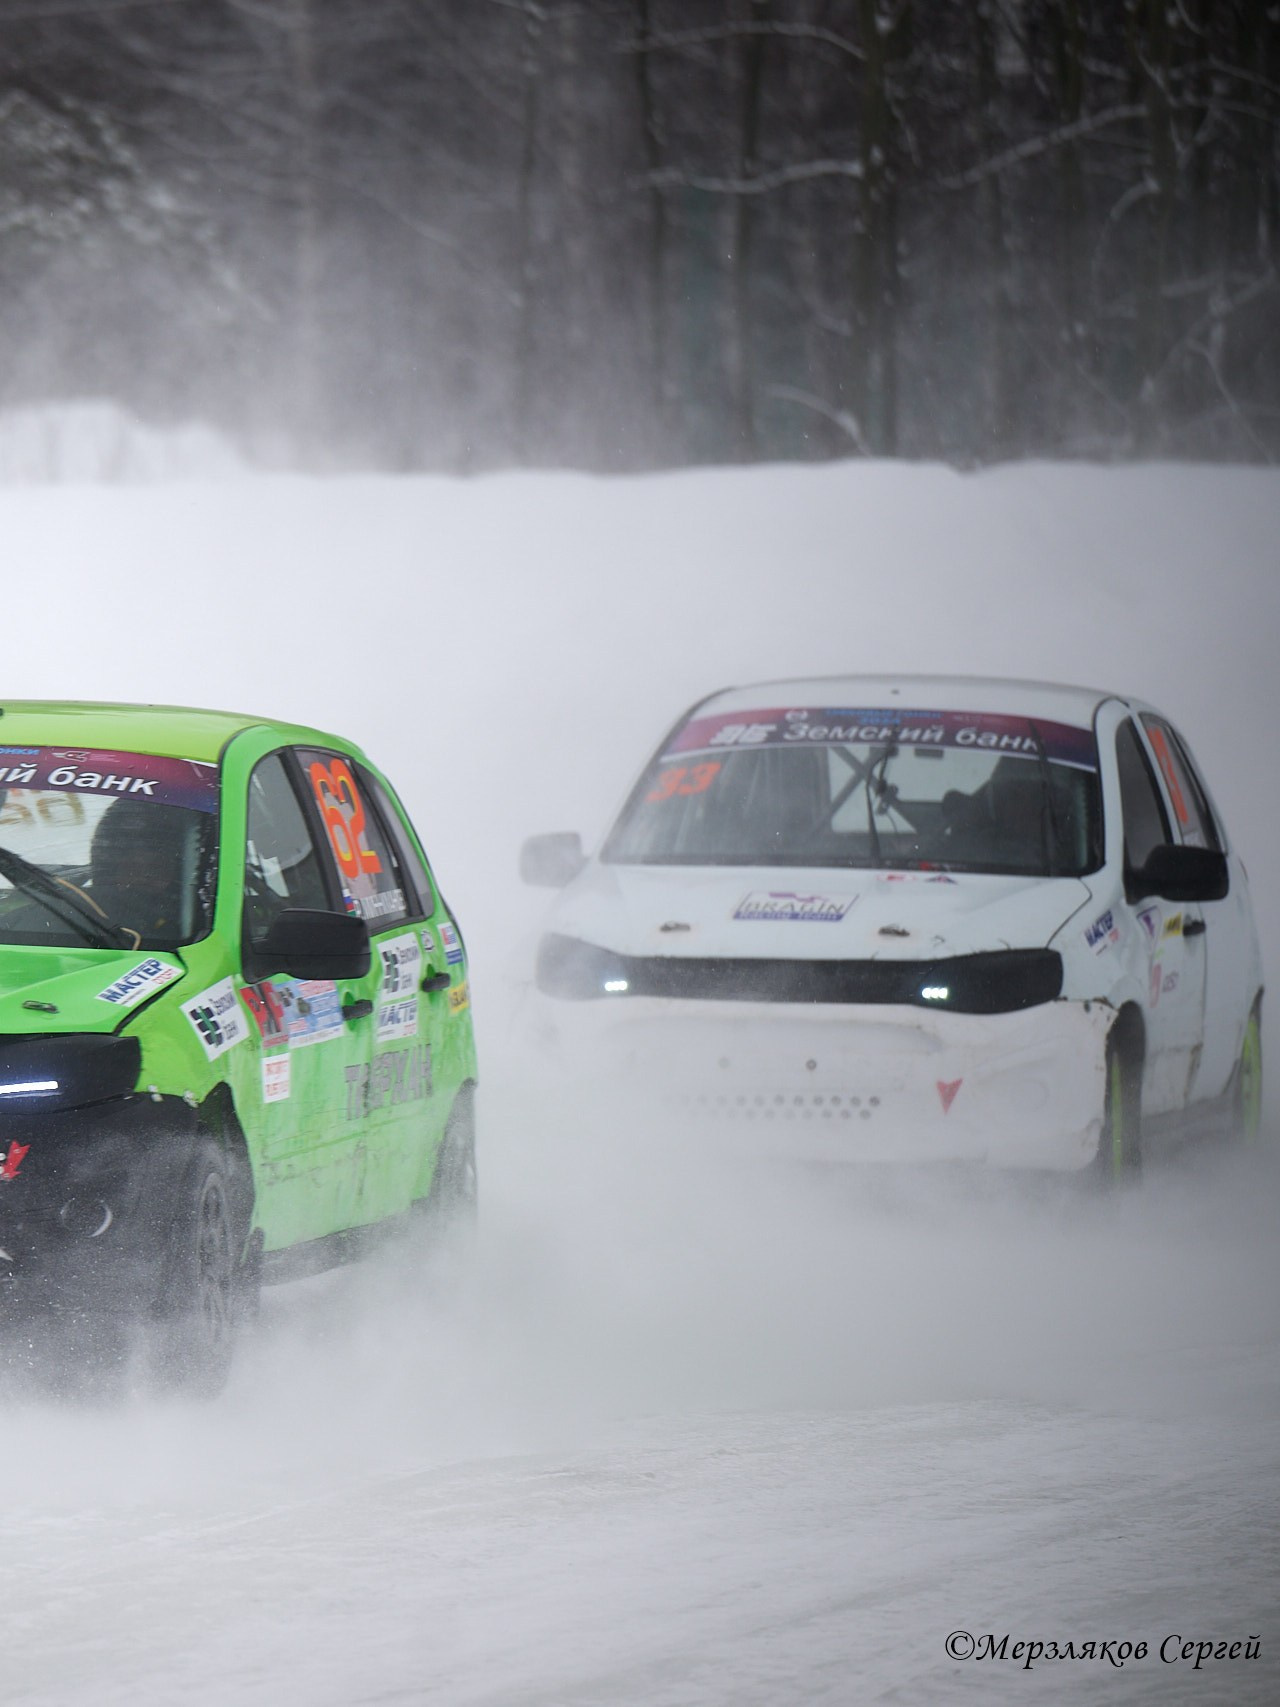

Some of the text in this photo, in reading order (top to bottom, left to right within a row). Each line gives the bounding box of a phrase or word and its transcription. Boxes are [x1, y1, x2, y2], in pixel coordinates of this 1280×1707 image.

[47, 765, 161, 796] банк
[309, 759, 384, 879] 62
[105, 959, 163, 1003] МАСТЕР
